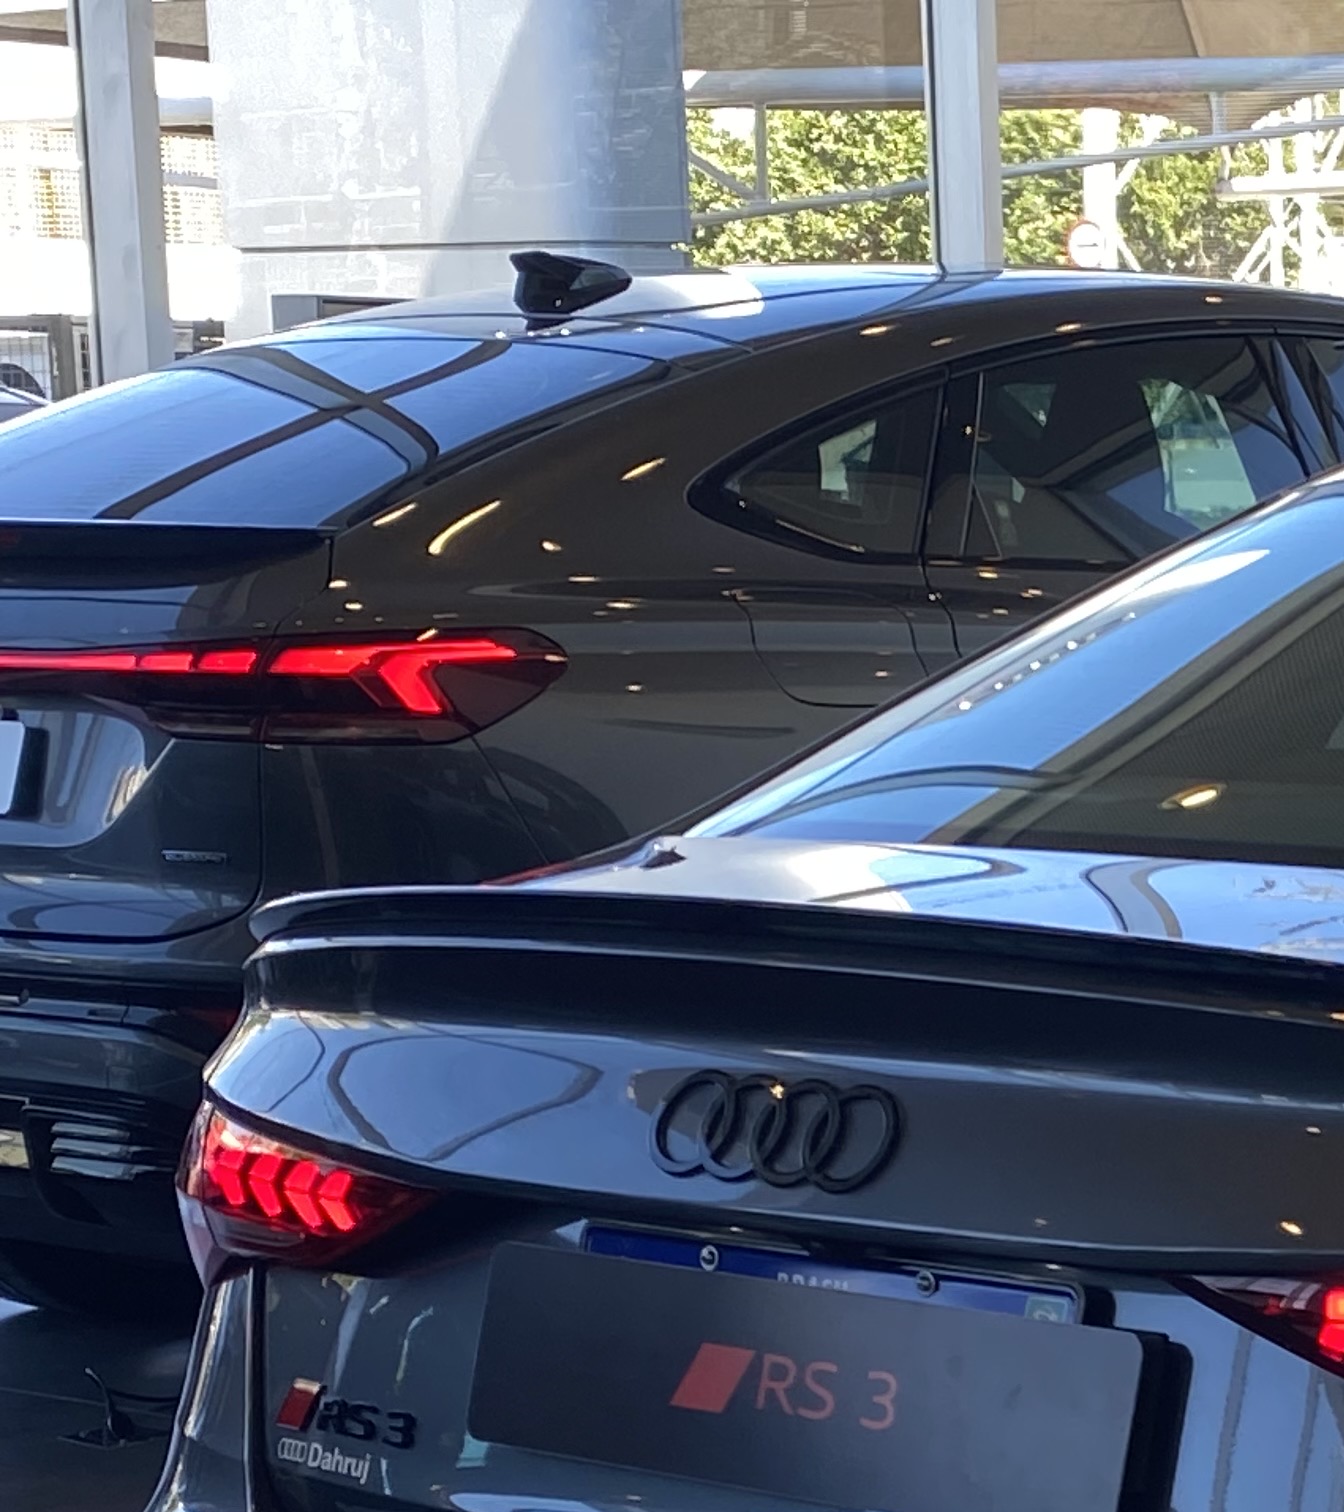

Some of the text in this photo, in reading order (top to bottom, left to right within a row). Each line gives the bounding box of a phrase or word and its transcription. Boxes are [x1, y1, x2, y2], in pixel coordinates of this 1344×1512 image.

[755, 1353, 900, 1432] RS 3
[316, 1398, 418, 1450] RS 3
[307, 1442, 372, 1485] Dahruj
